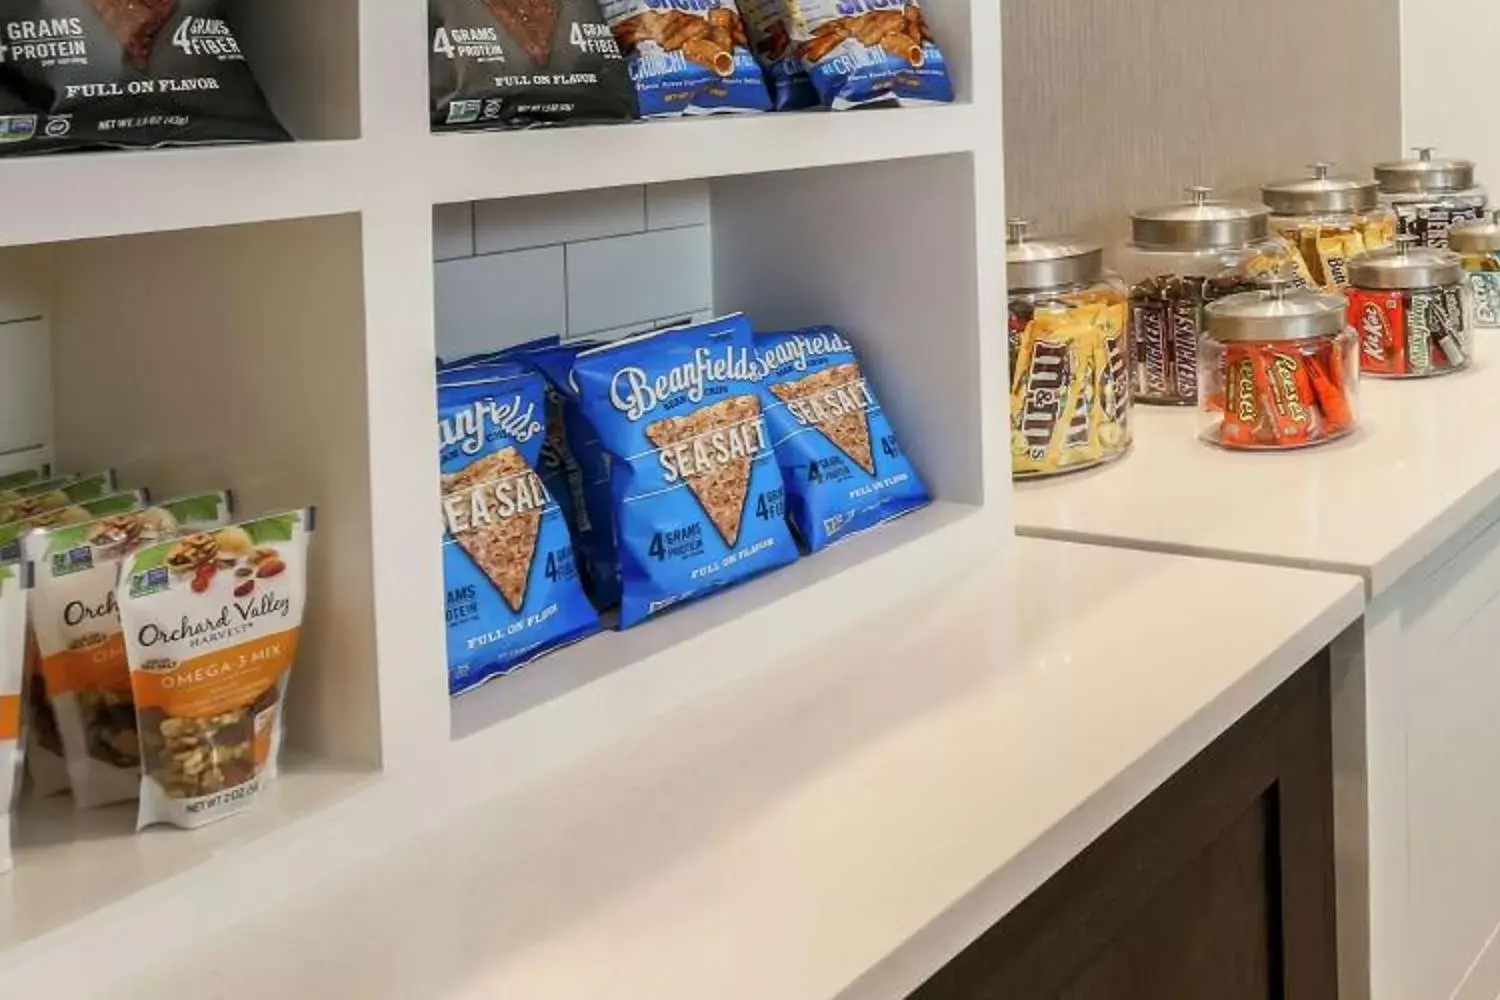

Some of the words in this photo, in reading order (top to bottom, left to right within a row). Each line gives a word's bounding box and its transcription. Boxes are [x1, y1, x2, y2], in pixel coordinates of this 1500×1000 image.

[7, 17, 83, 40] GRAMS
[172, 15, 192, 56] 4
[433, 26, 455, 59] 4
[451, 27, 497, 43] GRAMS
[569, 21, 588, 53] 4
[12, 39, 86, 62] PROTEIN
[191, 35, 241, 55] FIBER
[64, 82, 124, 99] FULL
[127, 80, 154, 94] ON
[158, 77, 220, 92] FLAVOR
[494, 76, 532, 87] FULL
[533, 75, 551, 85] ON
[1175, 317, 1198, 398] SNICKERS
[611, 345, 760, 422] Beanfields
[787, 396, 828, 425] SEA
[824, 377, 874, 415] SALT
[659, 441, 713, 483] SEA
[712, 418, 767, 464] SALT
[808, 461, 823, 485] 4
[755, 493, 770, 521] 4
[648, 530, 666, 562] 4
[545, 551, 558, 583] 4
[690, 563, 721, 580] FULL
[721, 556, 737, 567] ON
[138, 605, 233, 648] Orchard
[233, 591, 291, 620] Valley
[466, 629, 505, 650] FULL
[507, 622, 525, 635] ON
[250, 643, 282, 662] MIX
